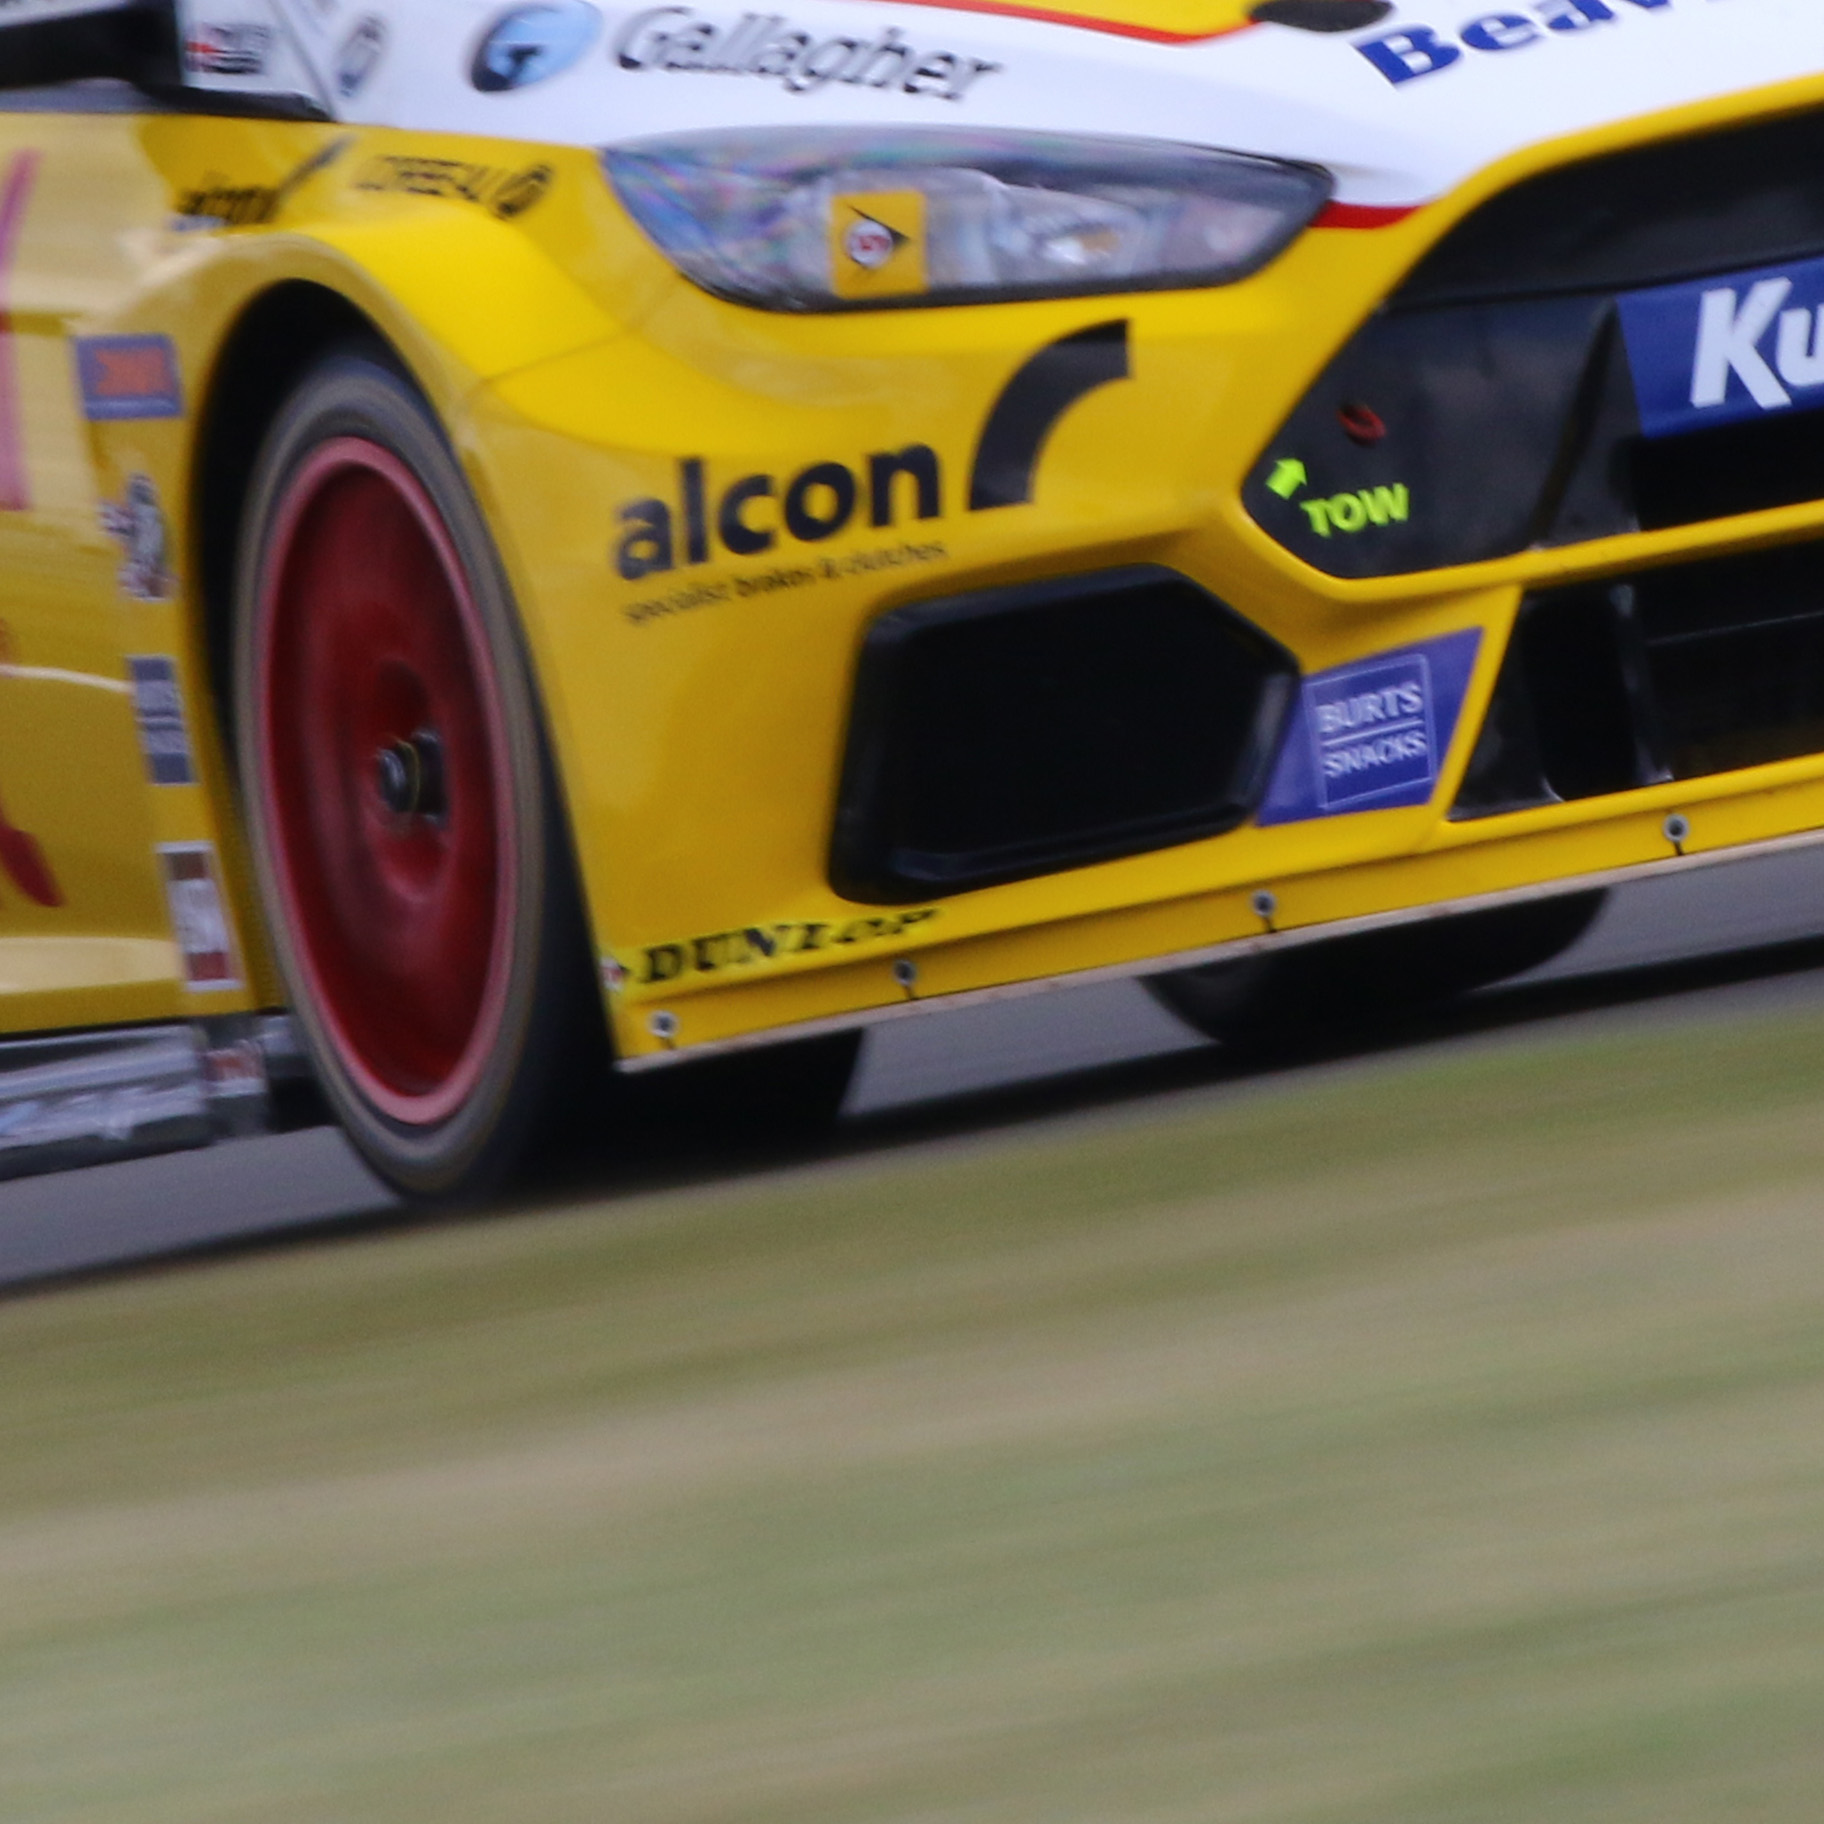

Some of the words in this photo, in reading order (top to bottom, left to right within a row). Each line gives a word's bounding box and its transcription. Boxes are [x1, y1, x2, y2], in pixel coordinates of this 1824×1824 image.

[609, 4, 1002, 102] Gallagher
[614, 442, 943, 581] alcon
[1299, 482, 1410, 538] TOW
[1316, 680, 1423, 734] BURTS
[1323, 729, 1428, 779] SNACKS
